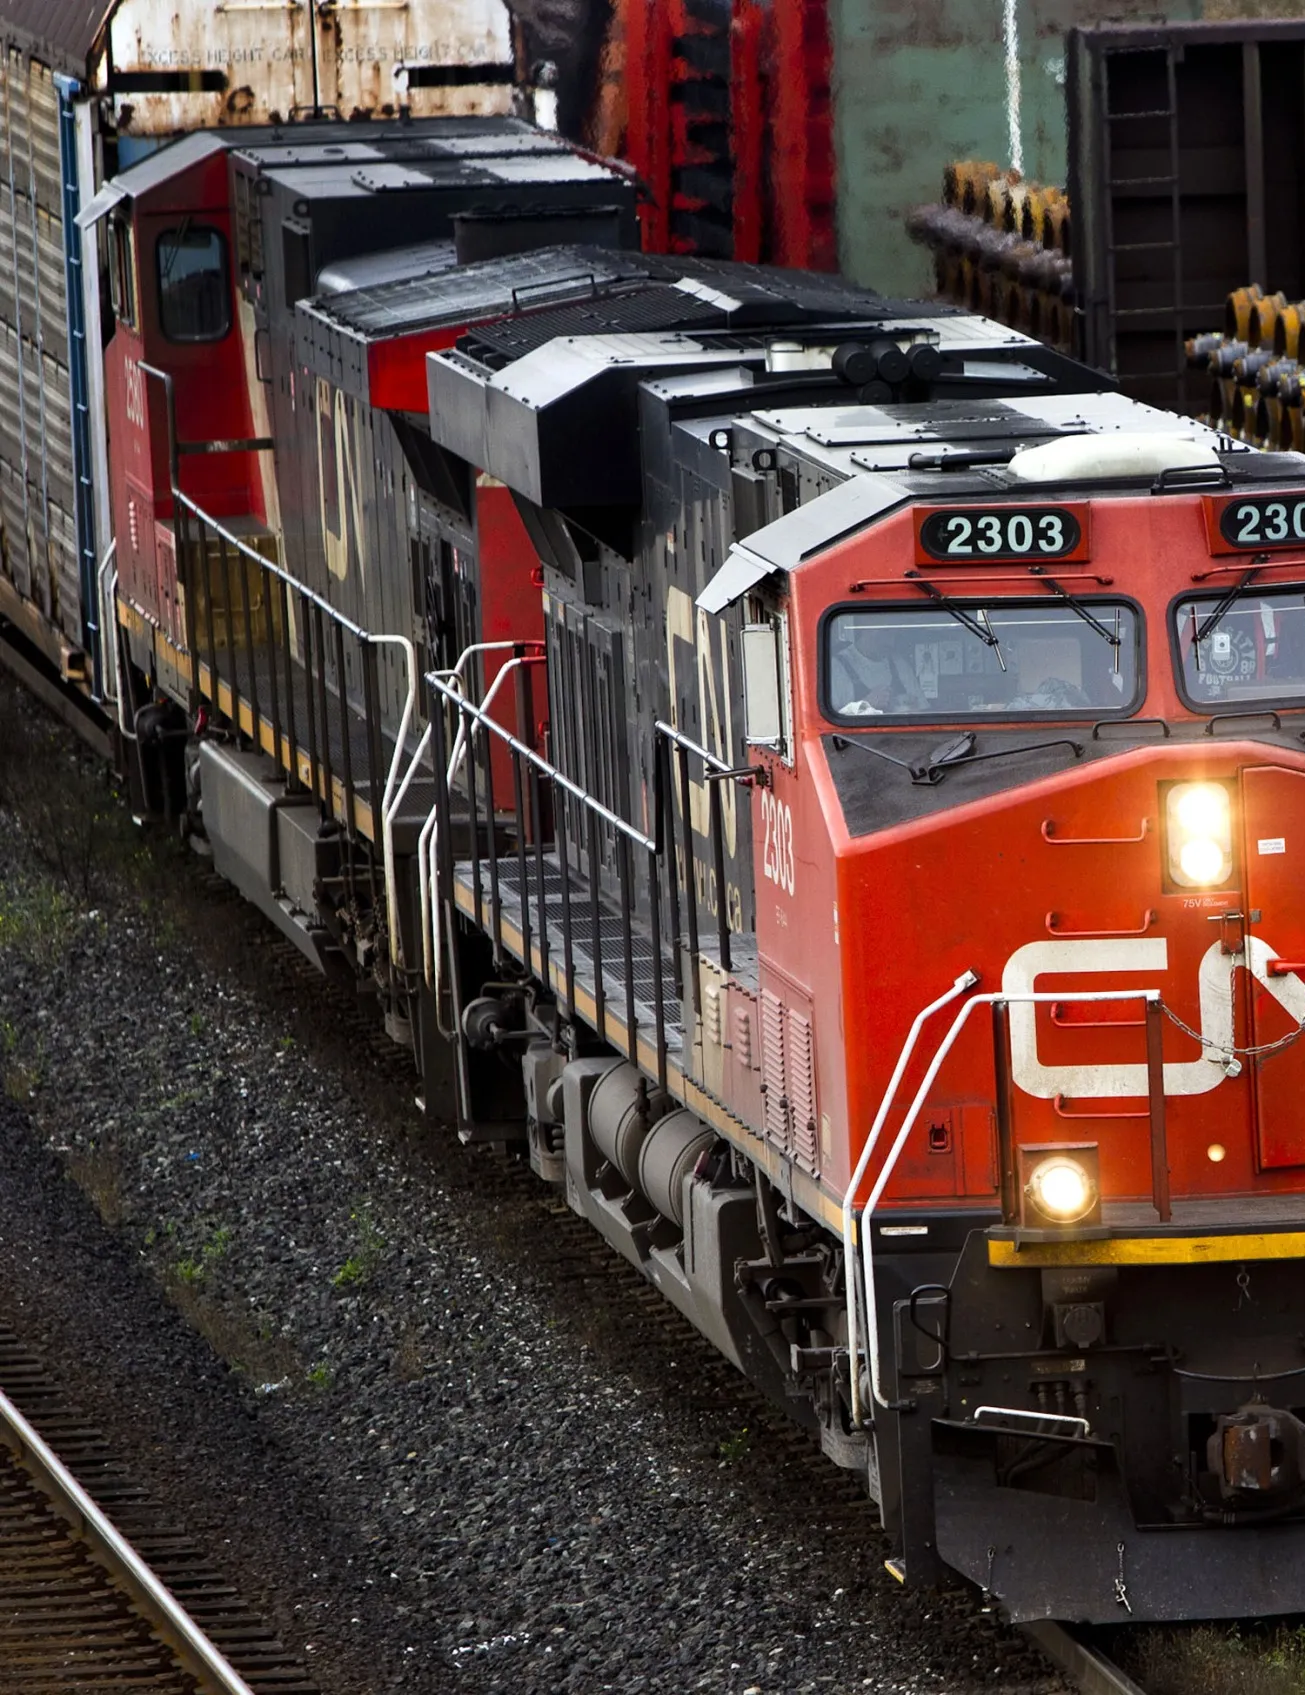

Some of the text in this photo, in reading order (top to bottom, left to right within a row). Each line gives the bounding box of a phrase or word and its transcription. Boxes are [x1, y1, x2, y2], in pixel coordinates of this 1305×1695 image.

[207, 47, 264, 64] HEIGHT
[946, 515, 1064, 554] 2303
[667, 584, 737, 859] CN
[761, 788, 795, 897] 2303
